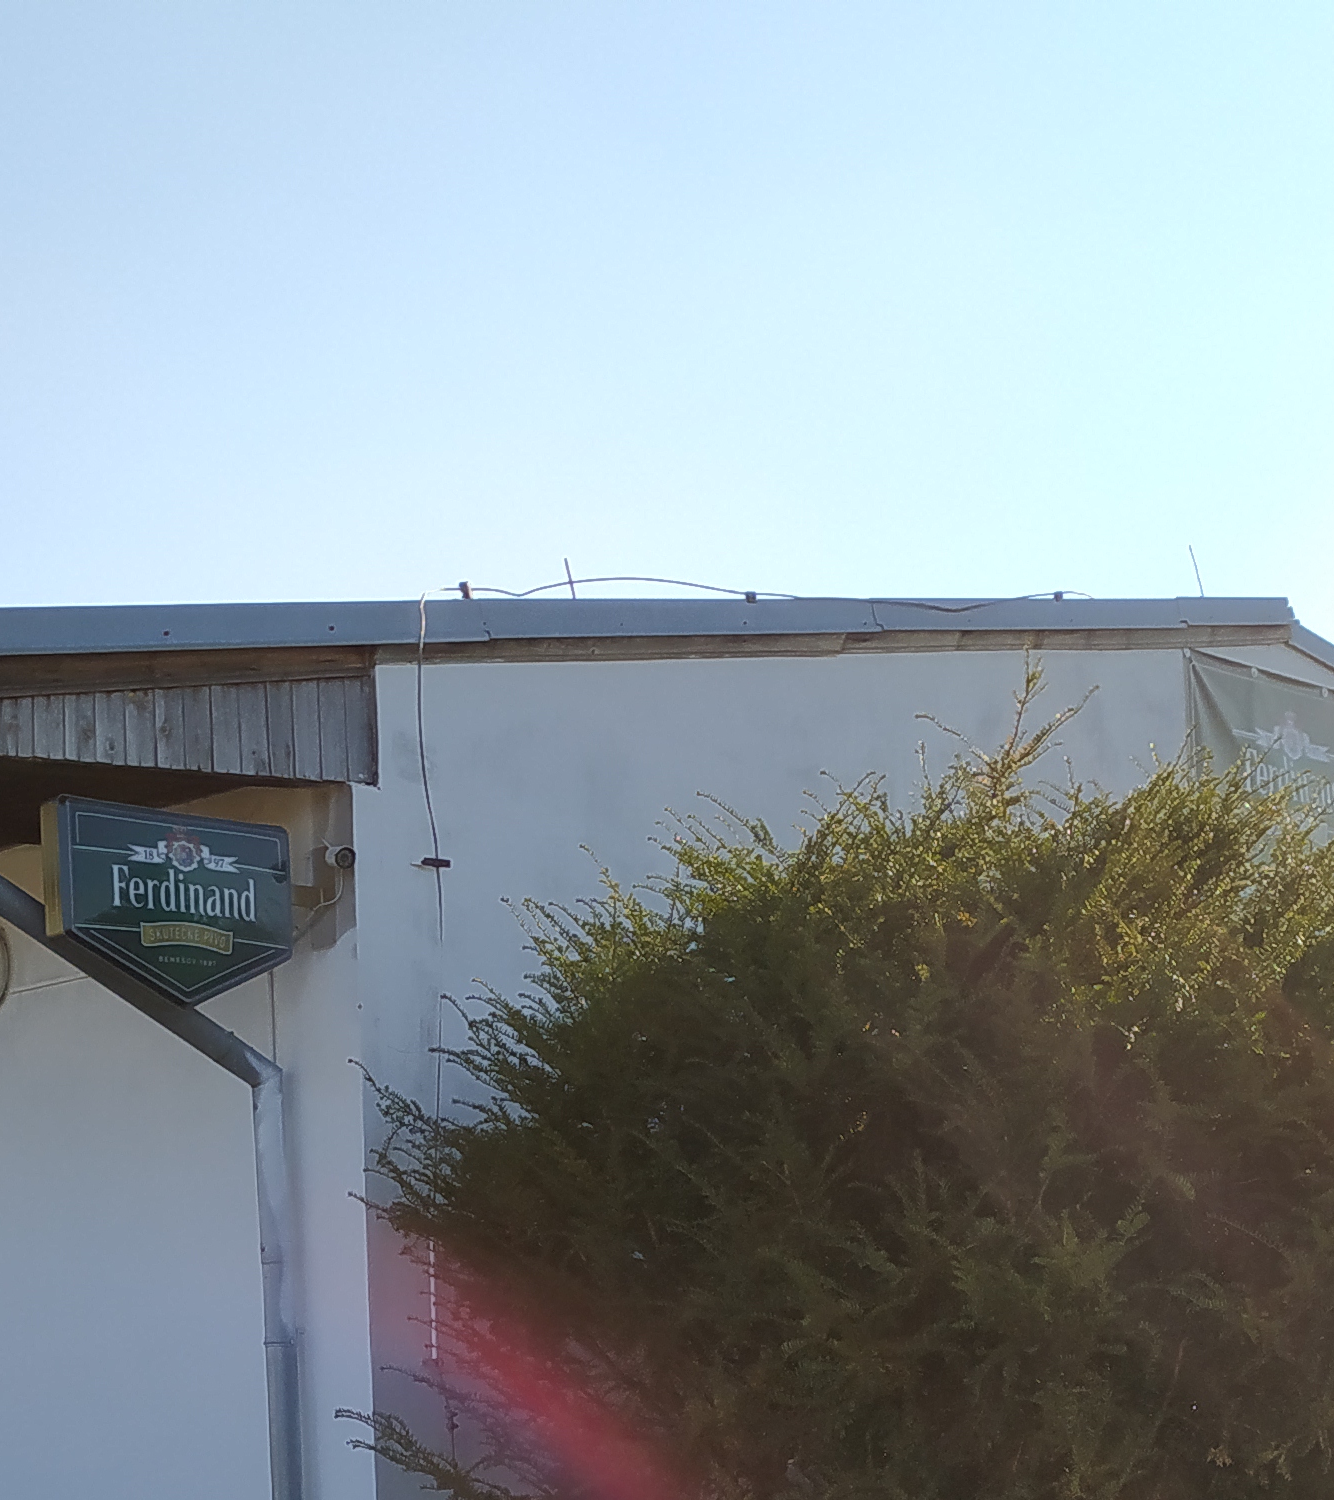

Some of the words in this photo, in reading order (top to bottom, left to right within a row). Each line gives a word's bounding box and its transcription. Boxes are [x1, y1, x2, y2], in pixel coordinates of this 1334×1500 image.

[143, 850, 154, 861] 18
[213, 858, 225, 869] 97
[111, 864, 257, 922] Ferdinand
[204, 931, 226, 948] PIVO
